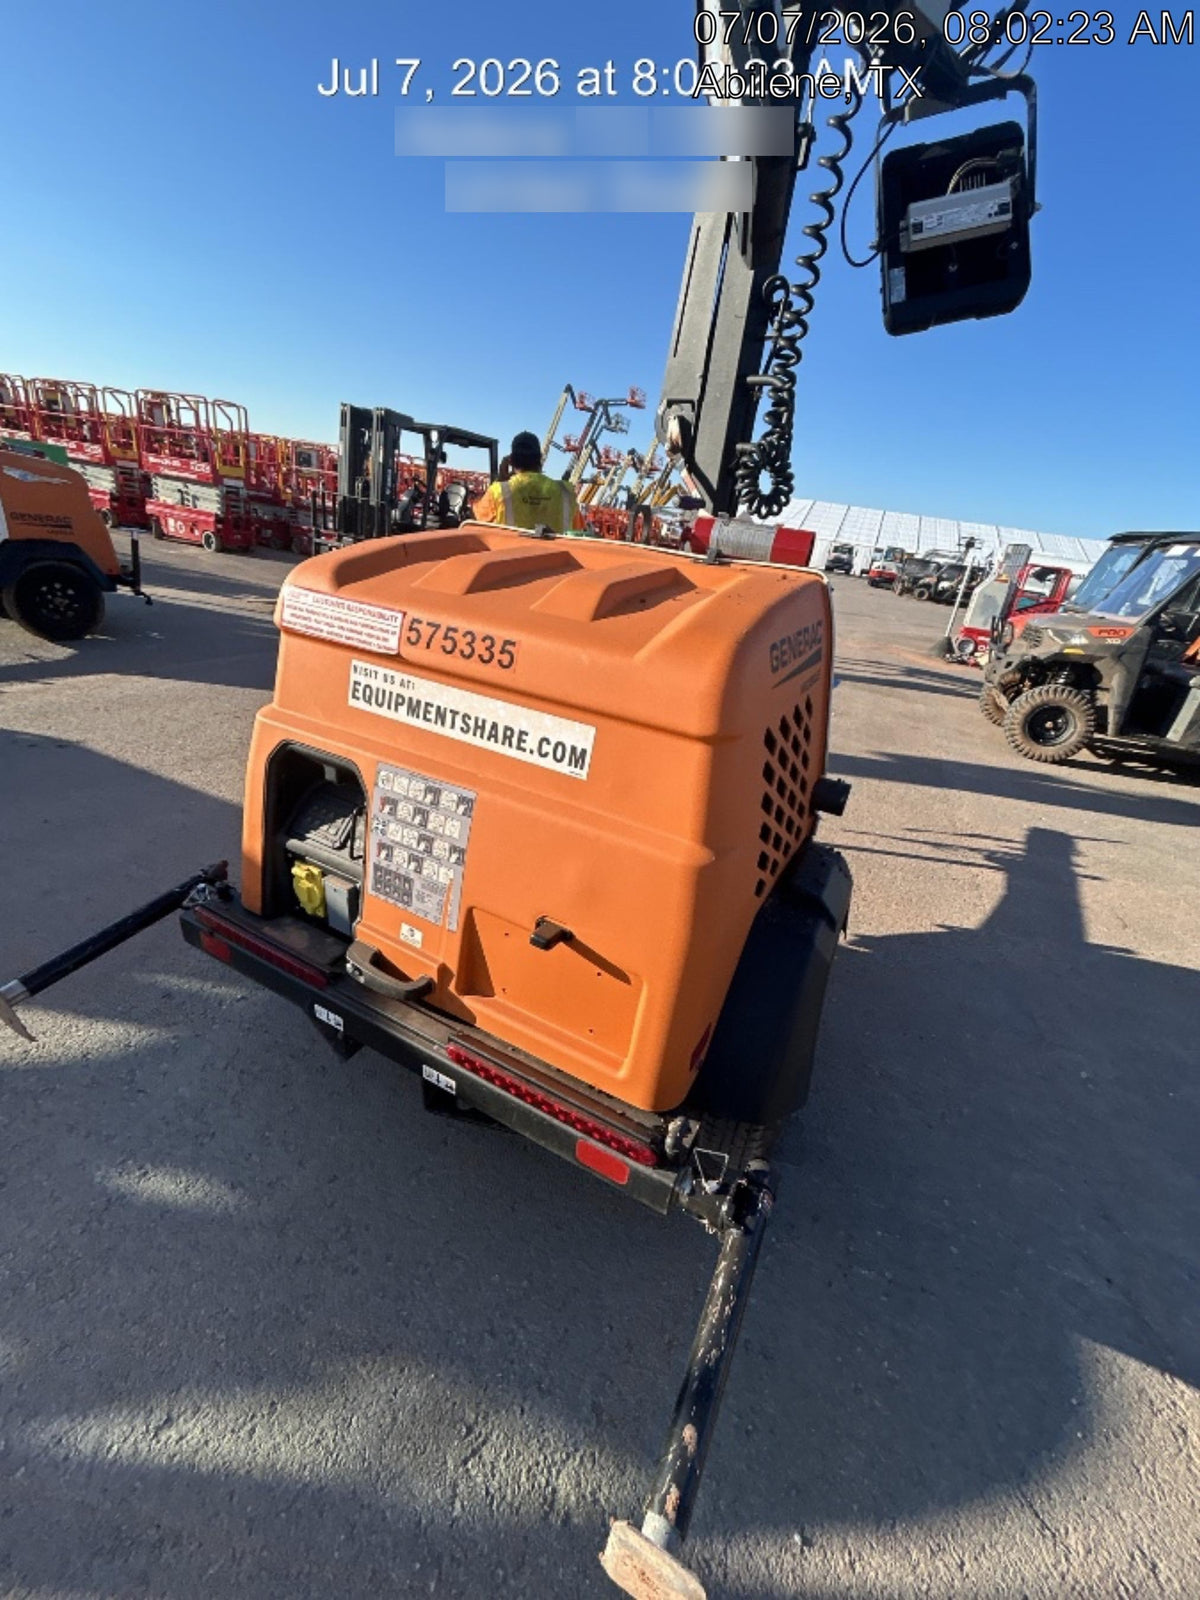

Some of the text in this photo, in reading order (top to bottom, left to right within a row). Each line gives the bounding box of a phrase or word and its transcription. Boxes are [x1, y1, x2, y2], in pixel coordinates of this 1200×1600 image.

[406, 617, 517, 670] 575335
[769, 619, 823, 675] GENERAC
[352, 664, 379, 681] VISIT
[382, 673, 396, 686] US
[351, 680, 588, 771] EQUIPMENTSHARE.COM
